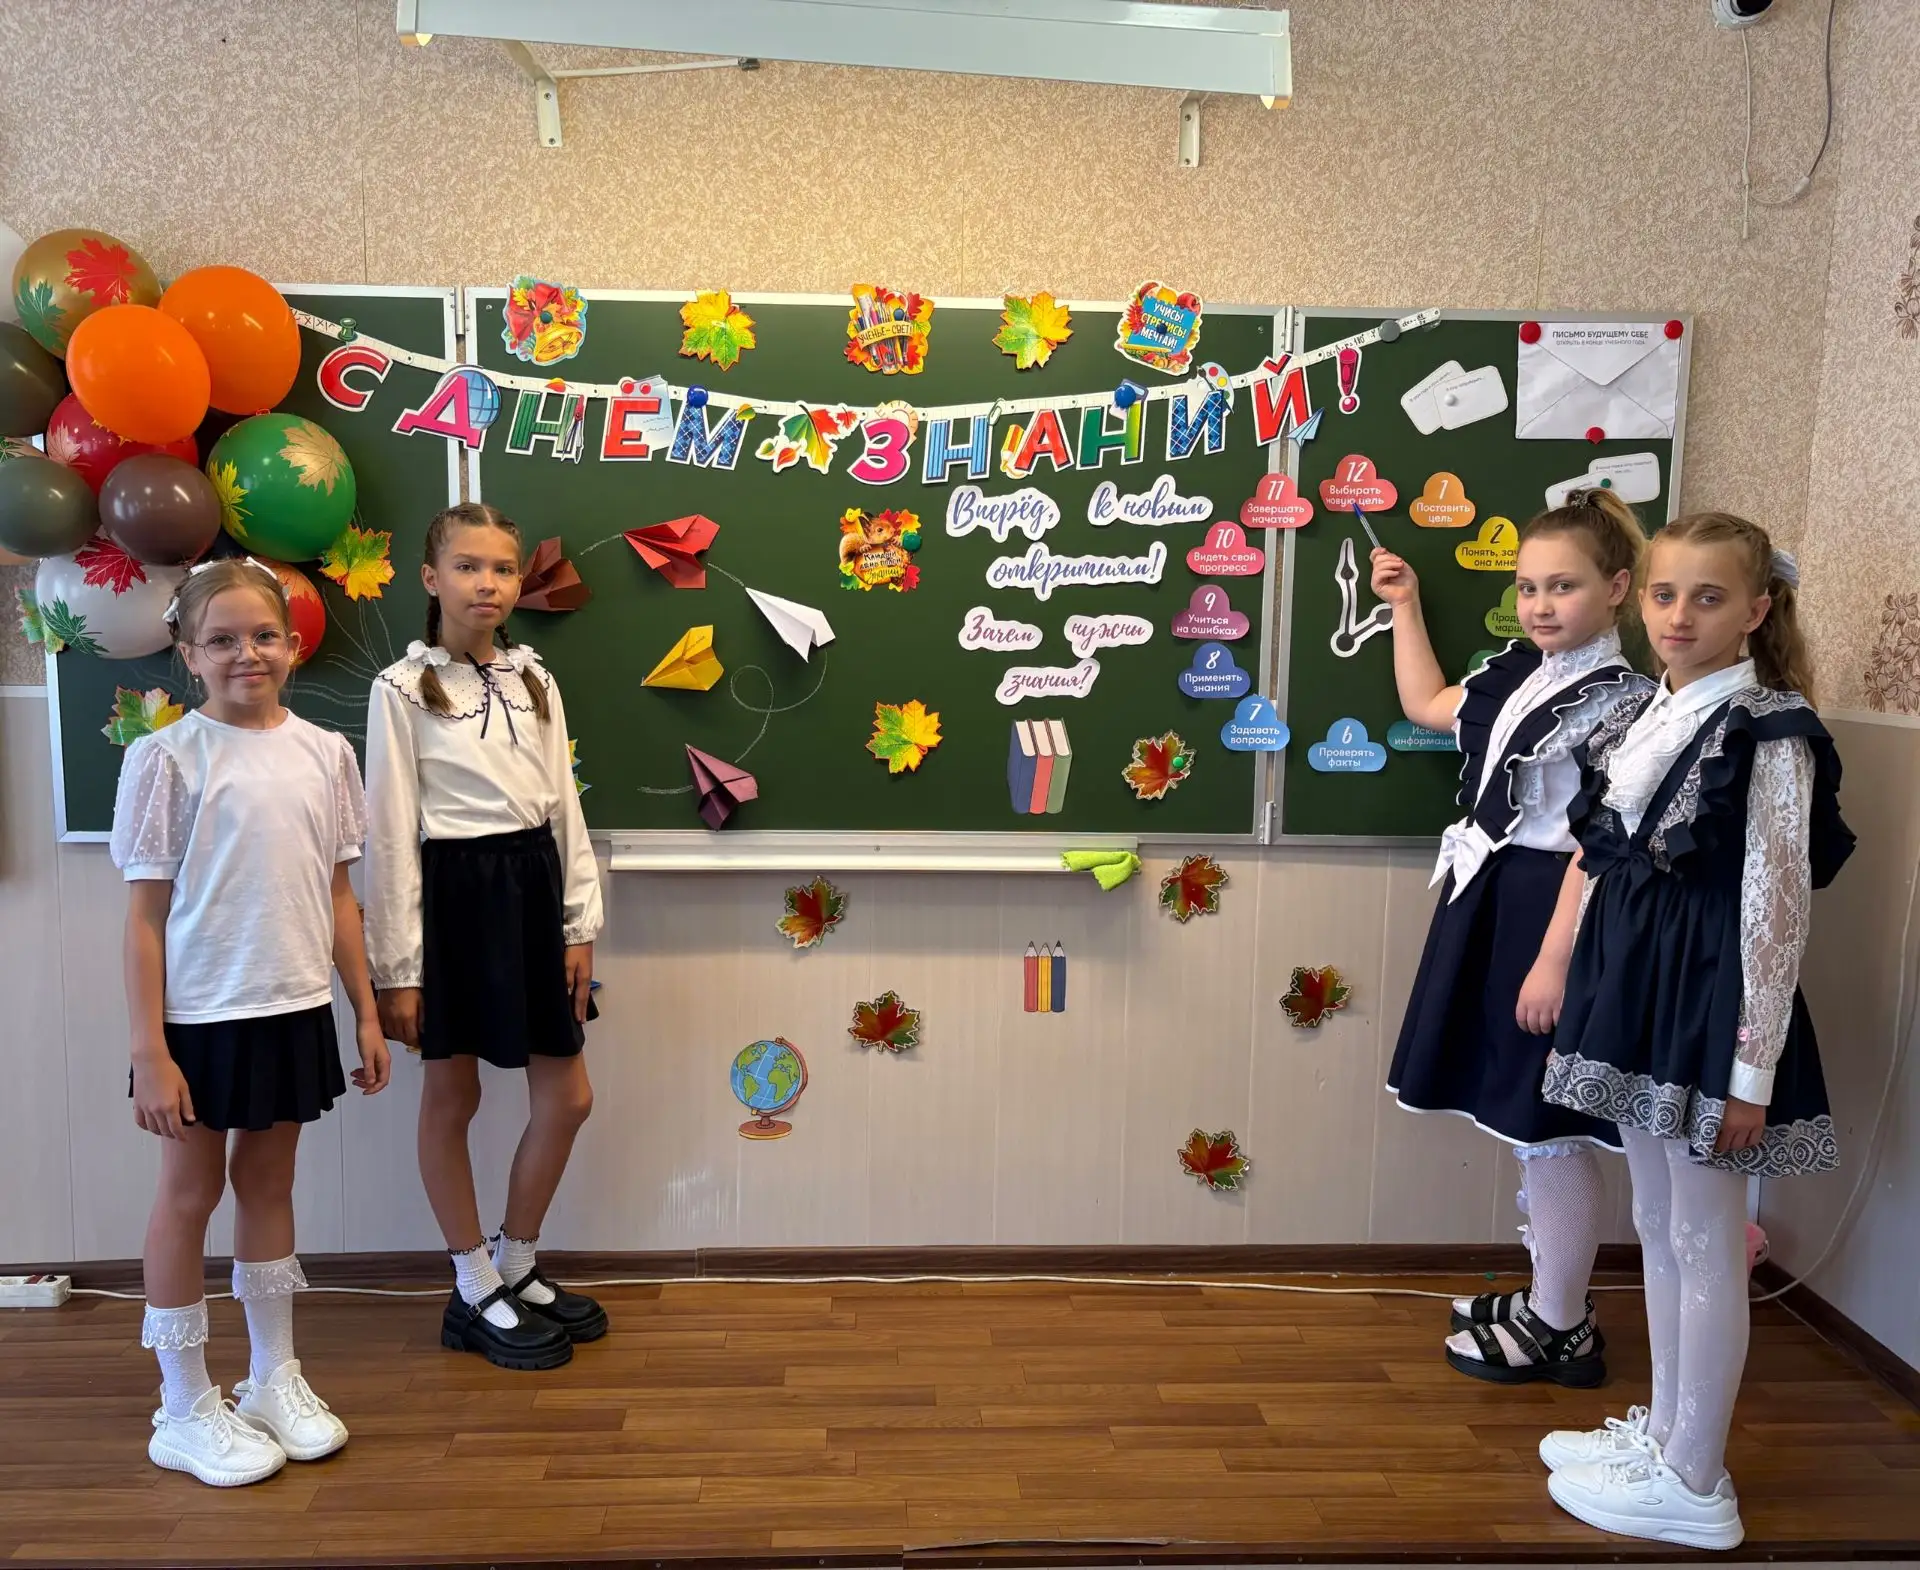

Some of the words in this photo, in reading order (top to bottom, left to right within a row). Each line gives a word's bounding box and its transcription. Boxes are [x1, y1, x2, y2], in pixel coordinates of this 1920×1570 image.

[1153, 302, 1184, 323] УЧИСЬ!
[1552, 330, 1586, 338] ПИСЬМО
[1587, 330, 1629, 339] БУДУЩЕМУ
[1630, 330, 1649, 339] СЕБЕ
[319, 344, 392, 411] С
[394, 371, 746, 469] ДНЁМ
[1346, 461, 1368, 482] 12
[1268, 480, 1285, 500] 11
[1329, 484, 1382, 496] Выбирать
[1439, 480, 1449, 500] 1
[1326, 497, 1356, 507] новую
[1358, 497, 1385, 507] цель
[952, 488, 1054, 536] Вперёд,
[1124, 482, 1206, 517] новым
[1247, 503, 1305, 515] Завершать
[1416, 503, 1471, 514] Поставить
[1251, 514, 1296, 525] начатое
[1428, 514, 1453, 525] цель
[1214, 528, 1235, 549] 10
[1490, 523, 1505, 544] 2
[1193, 551, 1229, 563] Видеть
[1231, 551, 1257, 562] свой
[1461, 546, 1499, 558] Понять,
[1502, 549, 1520, 557] зач
[1198, 563, 1247, 574] прогресс
[1474, 559, 1492, 567] она
[1495, 559, 1517, 567] мне
[993, 548, 1162, 594] открытиям!
[1204, 592, 1216, 611] 9
[1188, 614, 1229, 625] Учиться
[966, 613, 1035, 643] Зачем
[1071, 623, 1145, 651] нужны
[1176, 626, 1189, 635] на
[1190, 624, 1237, 636] ошибках
[1495, 625, 1524, 636] марш
[1206, 649, 1220, 669] 8
[1004, 664, 1092, 697] знания?
[1184, 673, 1242, 685] Применять
[1193, 684, 1230, 693] знания
[1249, 703, 1262, 721] 7
[1230, 725, 1280, 737] Задавать
[1341, 725, 1353, 744] 6
[1412, 725, 1440, 735] Иска
[1230, 736, 1276, 747] вопросы
[1394, 736, 1457, 747] информаци
[1319, 748, 1375, 760] Проверять
[1328, 757, 1361, 769] факты
[1559, 1324, 1592, 1362] STREE
